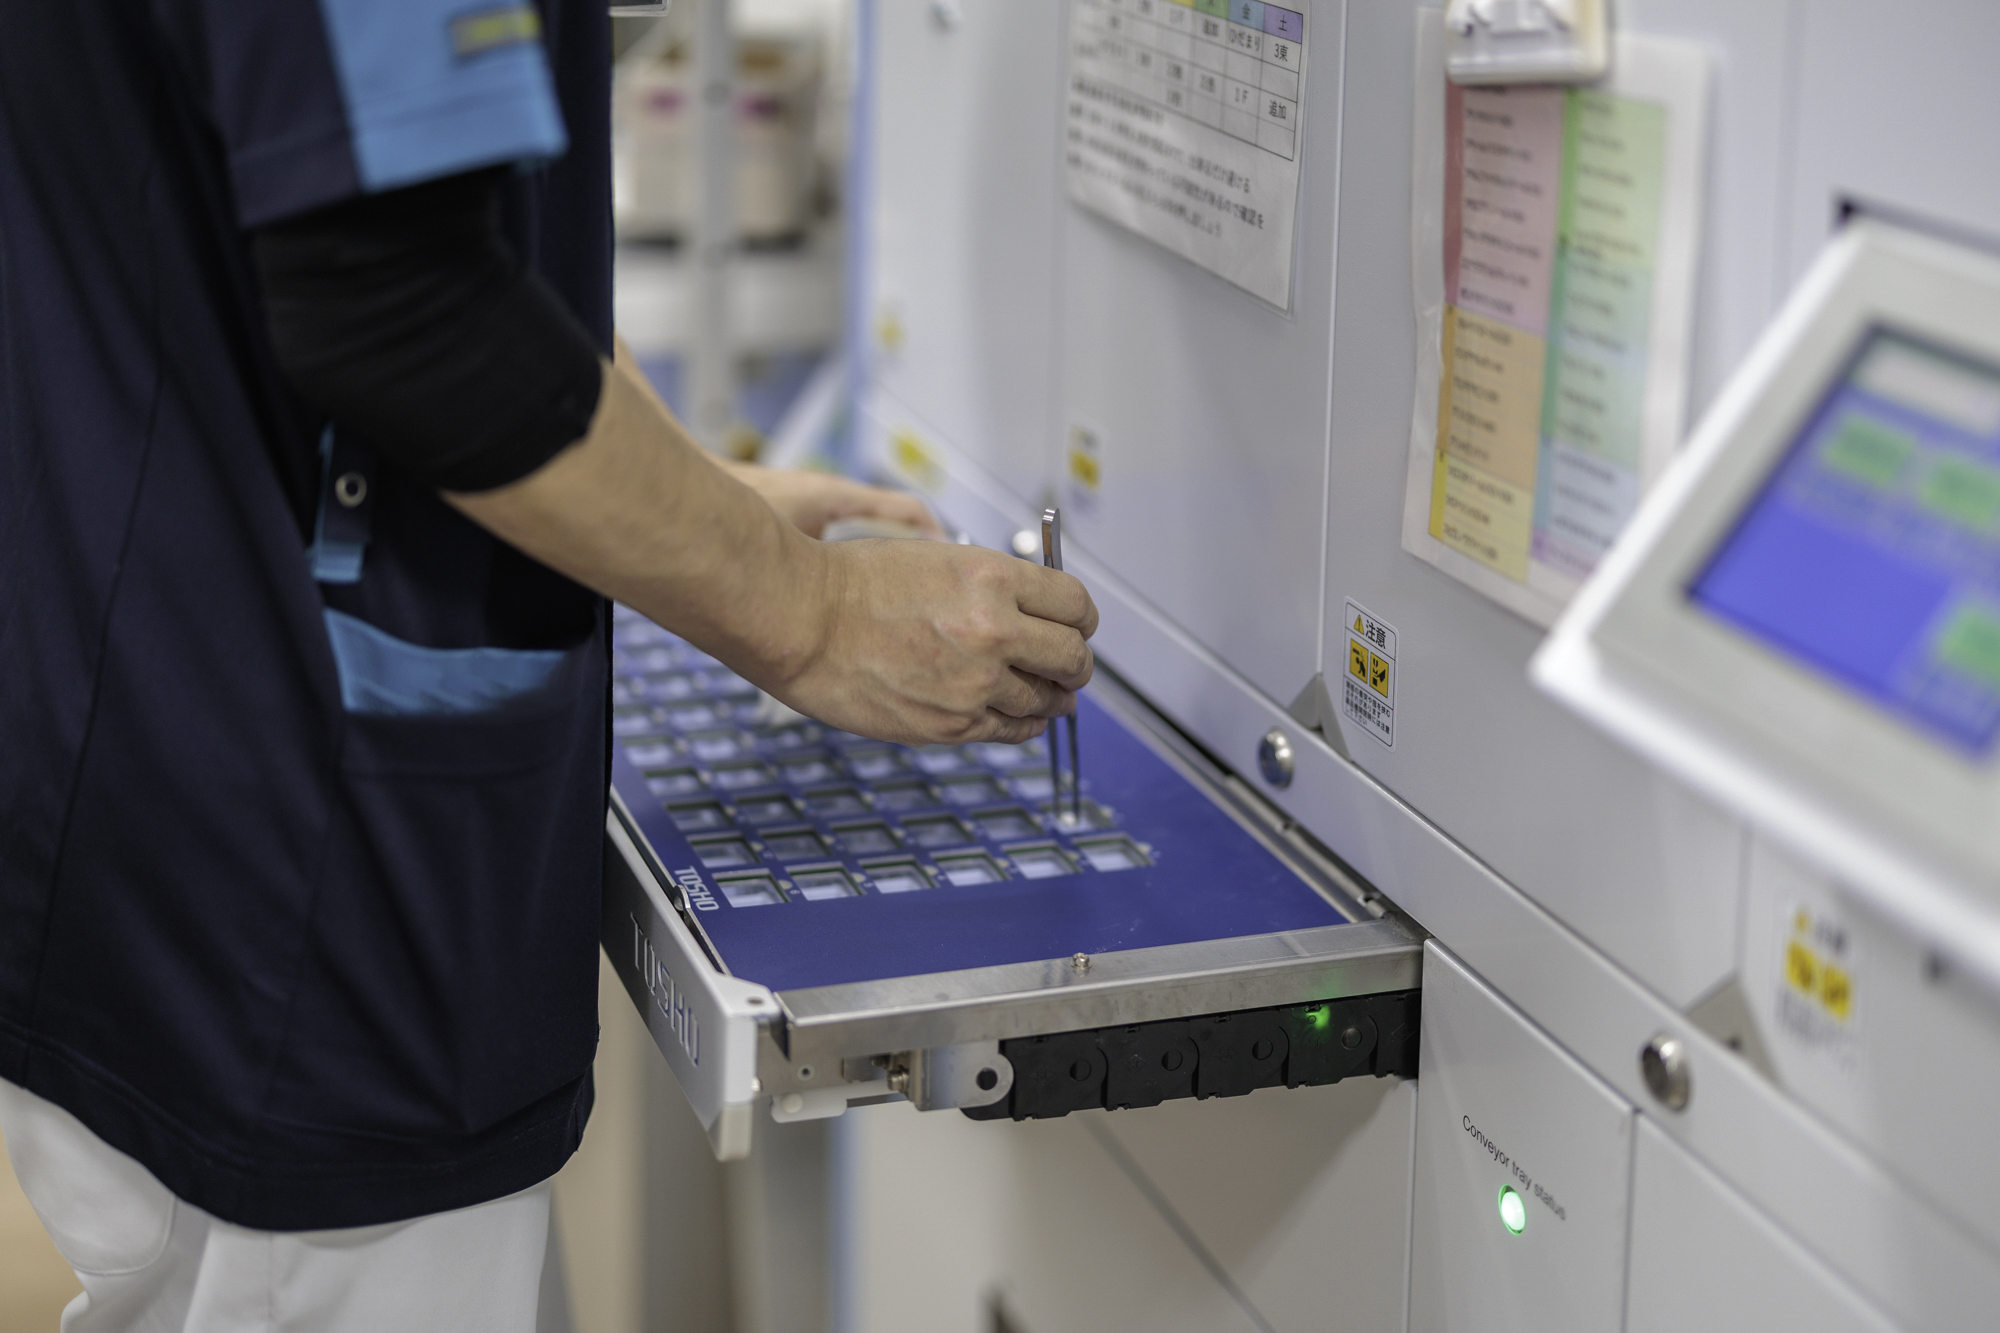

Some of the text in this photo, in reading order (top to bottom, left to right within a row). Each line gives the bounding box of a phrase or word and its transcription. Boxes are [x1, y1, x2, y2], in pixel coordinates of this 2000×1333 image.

[1241, 2, 1288, 32] 金 土
[1228, 28, 1261, 52] ひだまり
[1274, 43, 1289, 62] 3東
[1268, 99, 1287, 119] 追加
[1365, 619, 1387, 649] 注意
[674, 866, 719, 911] TOSHO
[630, 911, 699, 1068] TOSHO
[1462, 1115, 1566, 1220] Conveyor tray status
